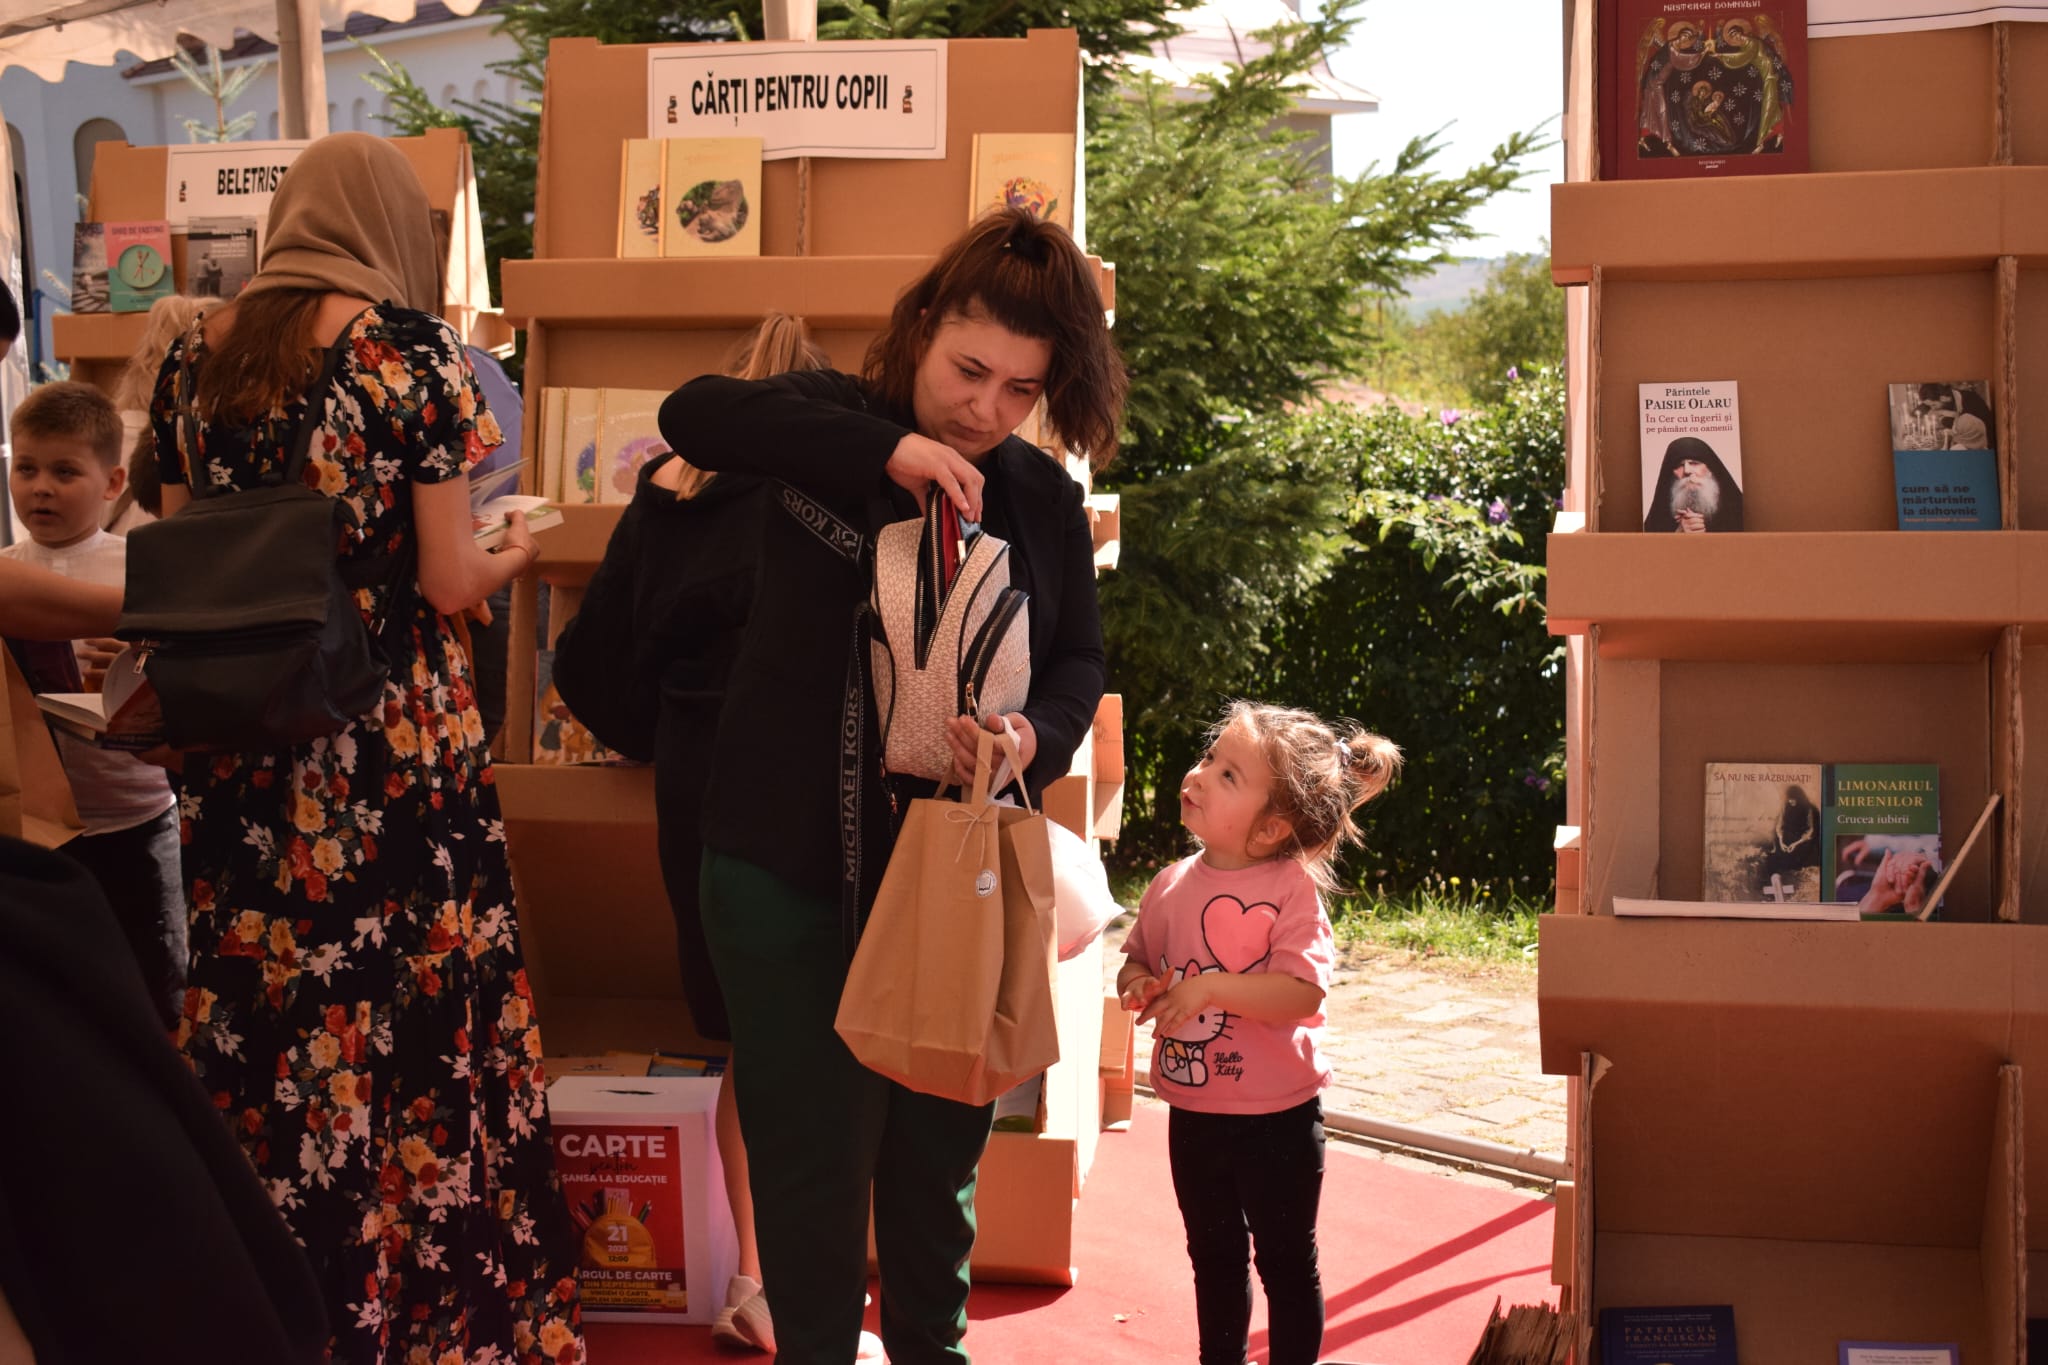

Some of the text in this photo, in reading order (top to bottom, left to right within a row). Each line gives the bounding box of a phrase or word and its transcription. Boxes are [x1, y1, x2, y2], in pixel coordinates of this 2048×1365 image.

[691, 71, 888, 127] CĂRȚI PENTRU COPII
[1665, 387, 1710, 397] Părintele
[1645, 398, 1732, 410] PAISIE OLARU
[1646, 413, 1656, 423] În
[1658, 415, 1675, 423] Cer
[1691, 413, 1722, 424] îngerii
[1700, 424, 1733, 432] oamenii
[1902, 485, 1929, 493] cum
[1953, 485, 1970, 493] ne
[1904, 506, 1977, 515] la duhovnic
[1728, 773, 1742, 782] NU
[1744, 773, 1757, 782] NE
[844, 687, 858, 882] MICHAEL KORS
[1838, 780, 1933, 791] LIMONARIUL
[1838, 796, 1923, 807] MIRENILOR
[1837, 813, 1910, 824] Crucea iubirii
[1213, 1051, 1244, 1064] Hello
[1214, 1064, 1245, 1082] Kitty
[560, 1134, 667, 1158] CARTE
[599, 1174, 613, 1183] LA
[615, 1174, 668, 1186] EDUCAȚIE
[607, 1225, 628, 1242] 21
[616, 1271, 632, 1280] DE
[634, 1271, 673, 1281] CARTE
[1625, 1326, 1716, 1334] PATERICUL
[1625, 1334, 1716, 1342] FRANCISCAN
